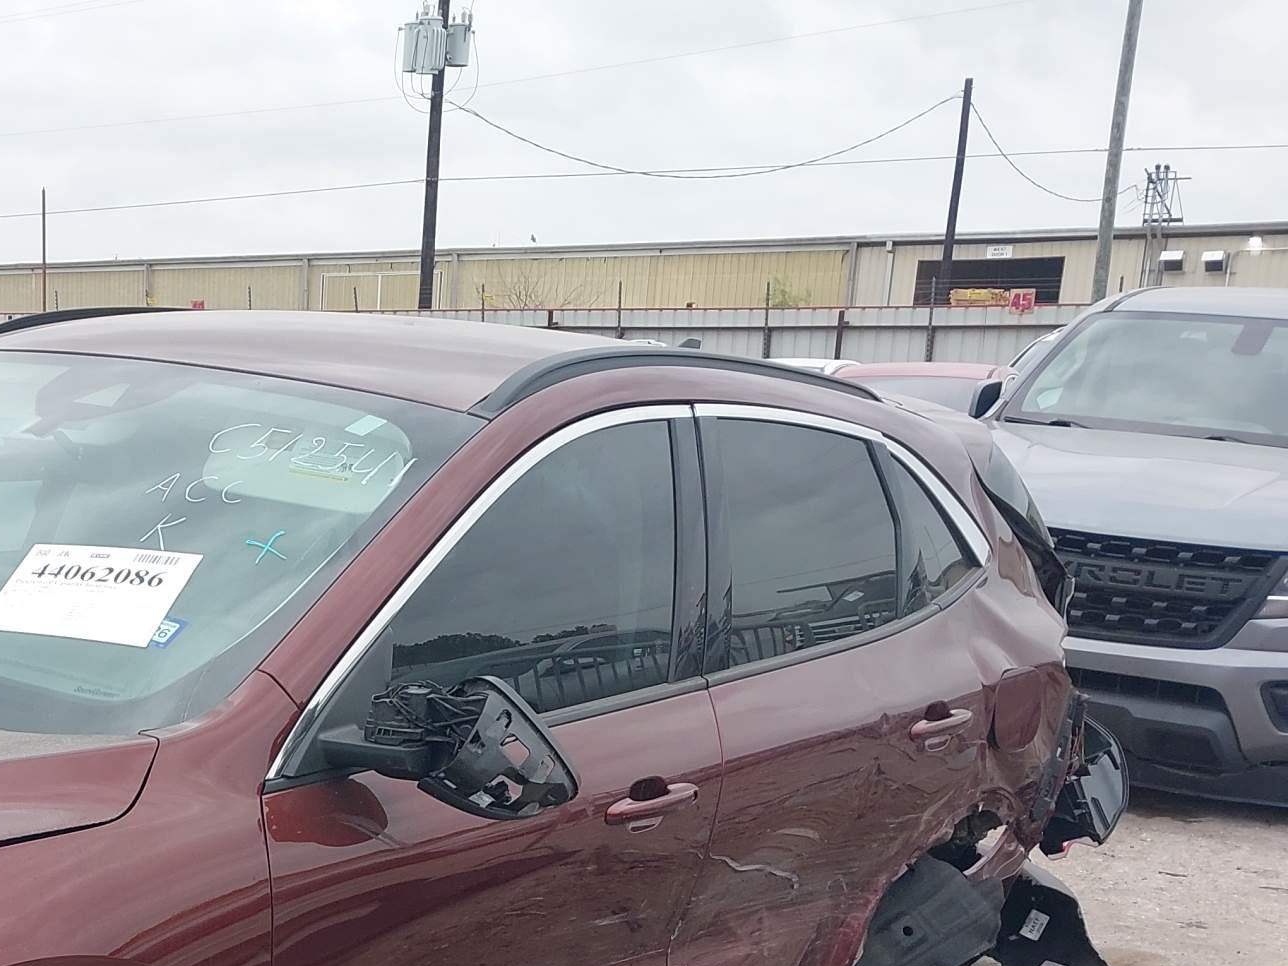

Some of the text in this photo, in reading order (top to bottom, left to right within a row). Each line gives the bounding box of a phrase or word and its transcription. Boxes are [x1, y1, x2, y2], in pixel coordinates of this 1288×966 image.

[1011, 292, 1034, 311] 45
[145, 471, 244, 505] ACC
[139, 512, 188, 551] K
[30, 562, 168, 589] 44062086
